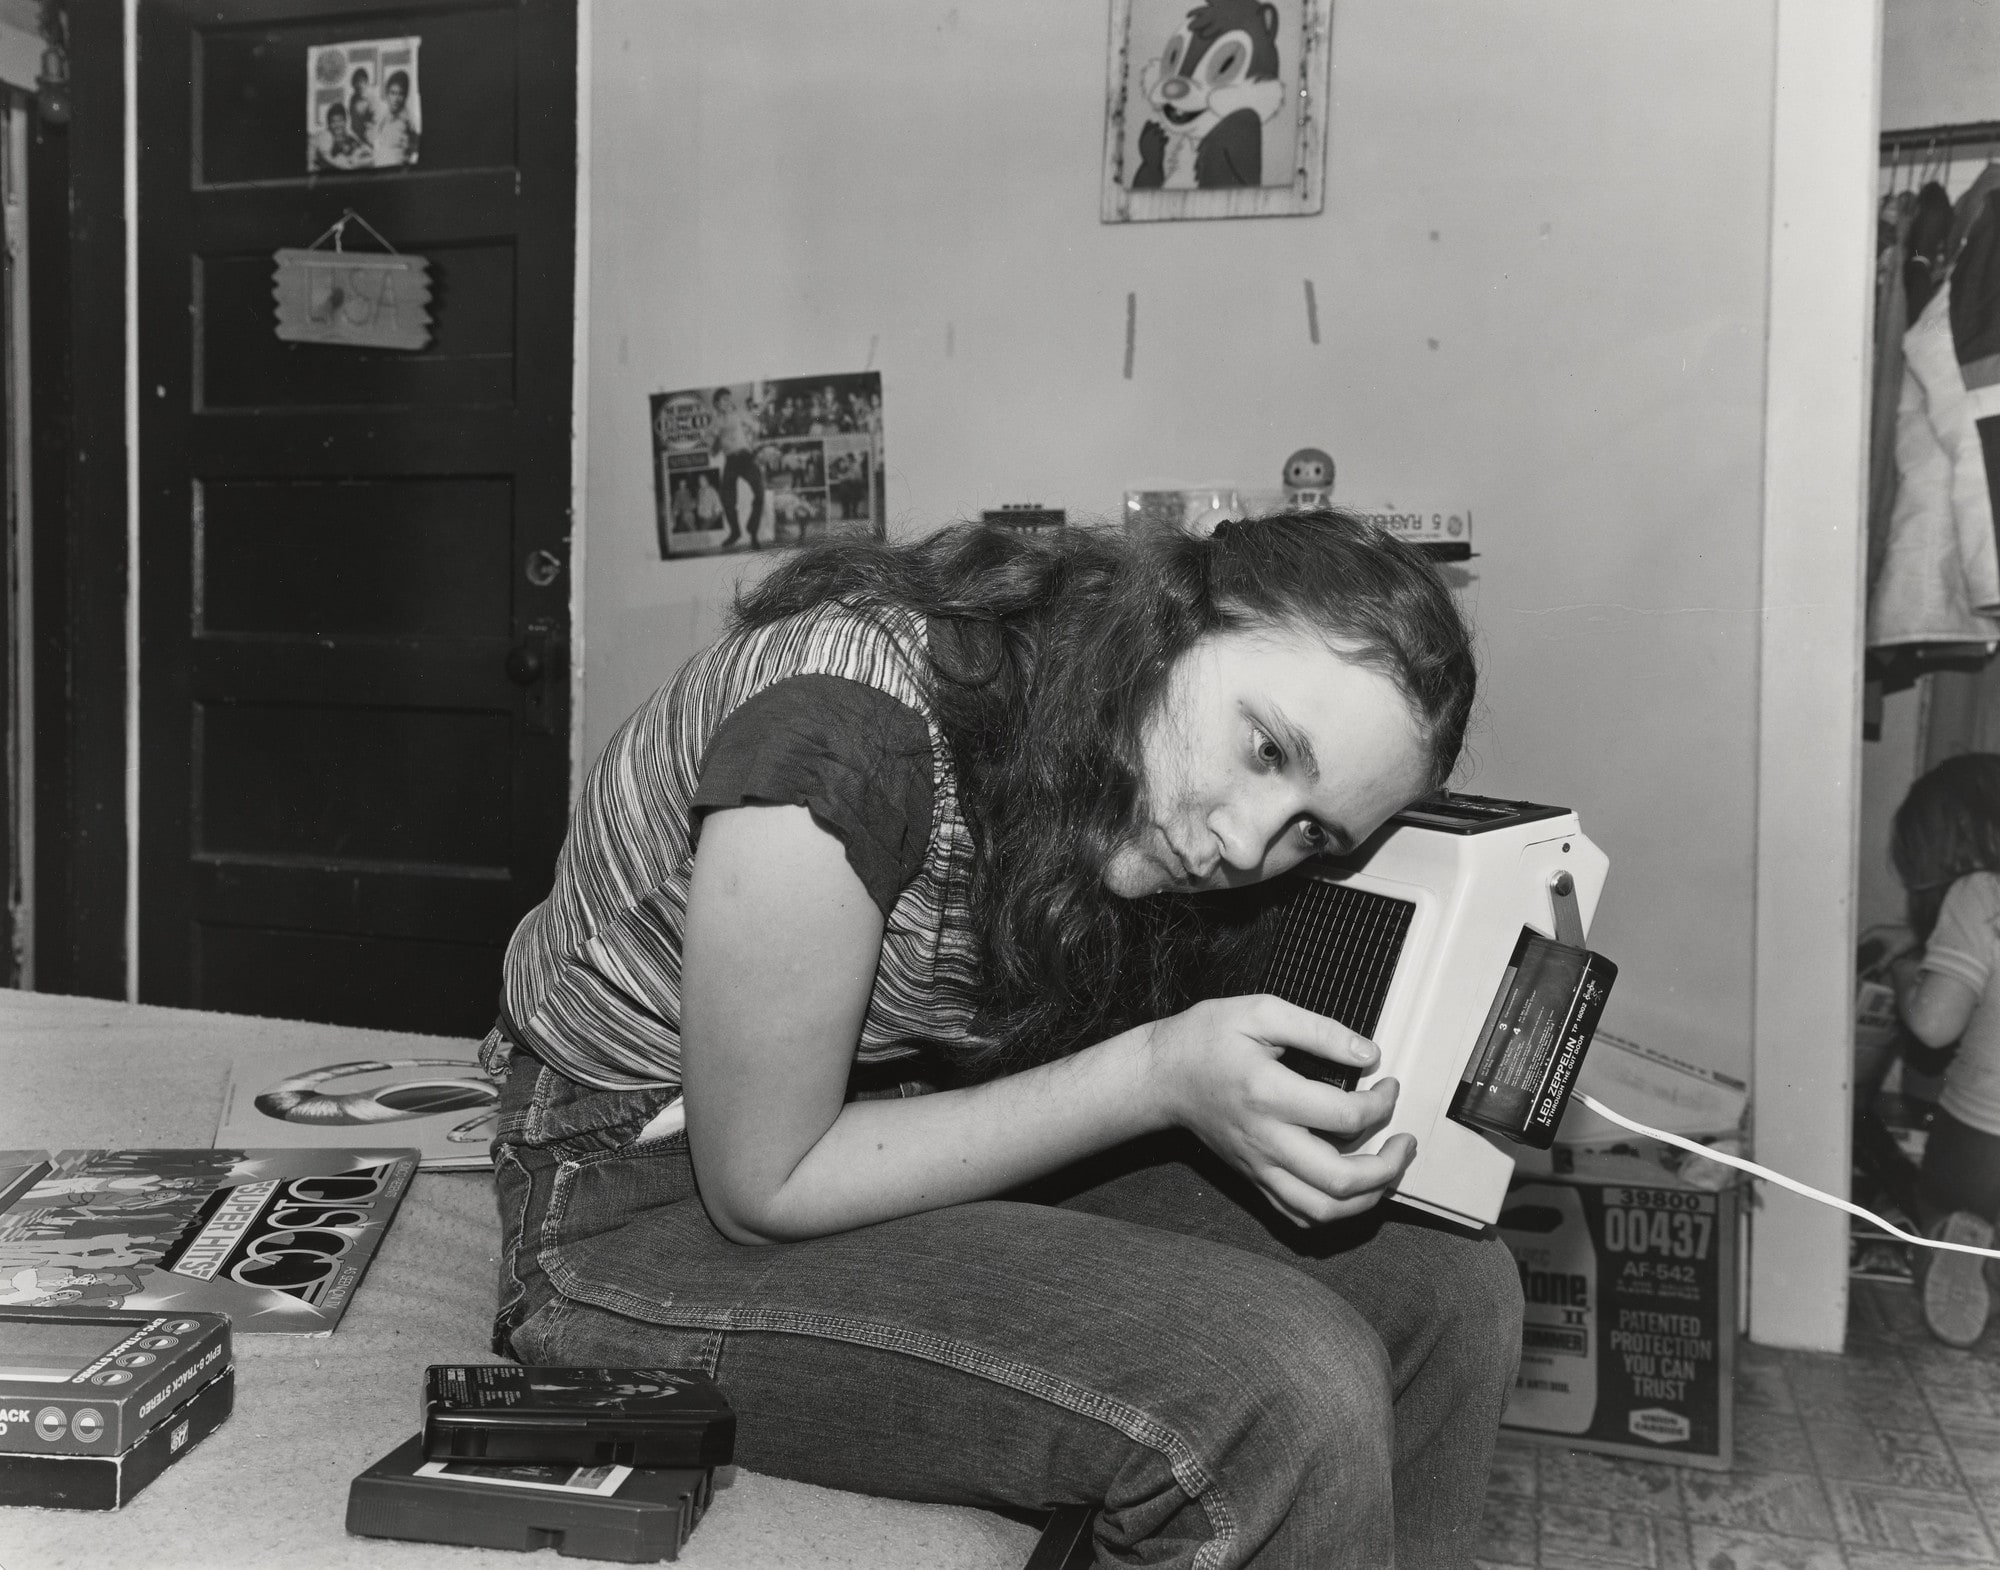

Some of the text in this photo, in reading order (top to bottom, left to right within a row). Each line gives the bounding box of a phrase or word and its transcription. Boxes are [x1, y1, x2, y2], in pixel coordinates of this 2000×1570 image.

[1499, 1023, 1508, 1031] 3
[1513, 1027, 1521, 1035] 4
[1571, 1002, 1587, 1033] TP 16002
[1489, 1085, 1498, 1093] 2
[1537, 1097, 1553, 1124] LED
[1547, 1036, 1577, 1097] ZEPPELIN
[1544, 1035, 1585, 1127] IN THROUGH THE OUT DOOR
[1620, 1189, 1700, 1210] 39800
[230, 1172, 390, 1295] DISCO
[1605, 1207, 1712, 1259] 00437
[325, 1266, 358, 1309] AS SEEN ON TV
[1623, 1261, 1695, 1283] AF-542
[1619, 1309, 1701, 1338] PATENTED
[71, 1317, 167, 1384] EPIC 8-TRACK STEREO
[1611, 1330, 1712, 1361] PROTECTION
[139, 1343, 222, 1419] EPIC 8-TRACK STEREO
[1623, 1353, 1696, 1381] YOU CAN
[1633, 1376, 1686, 1401] TRUST
